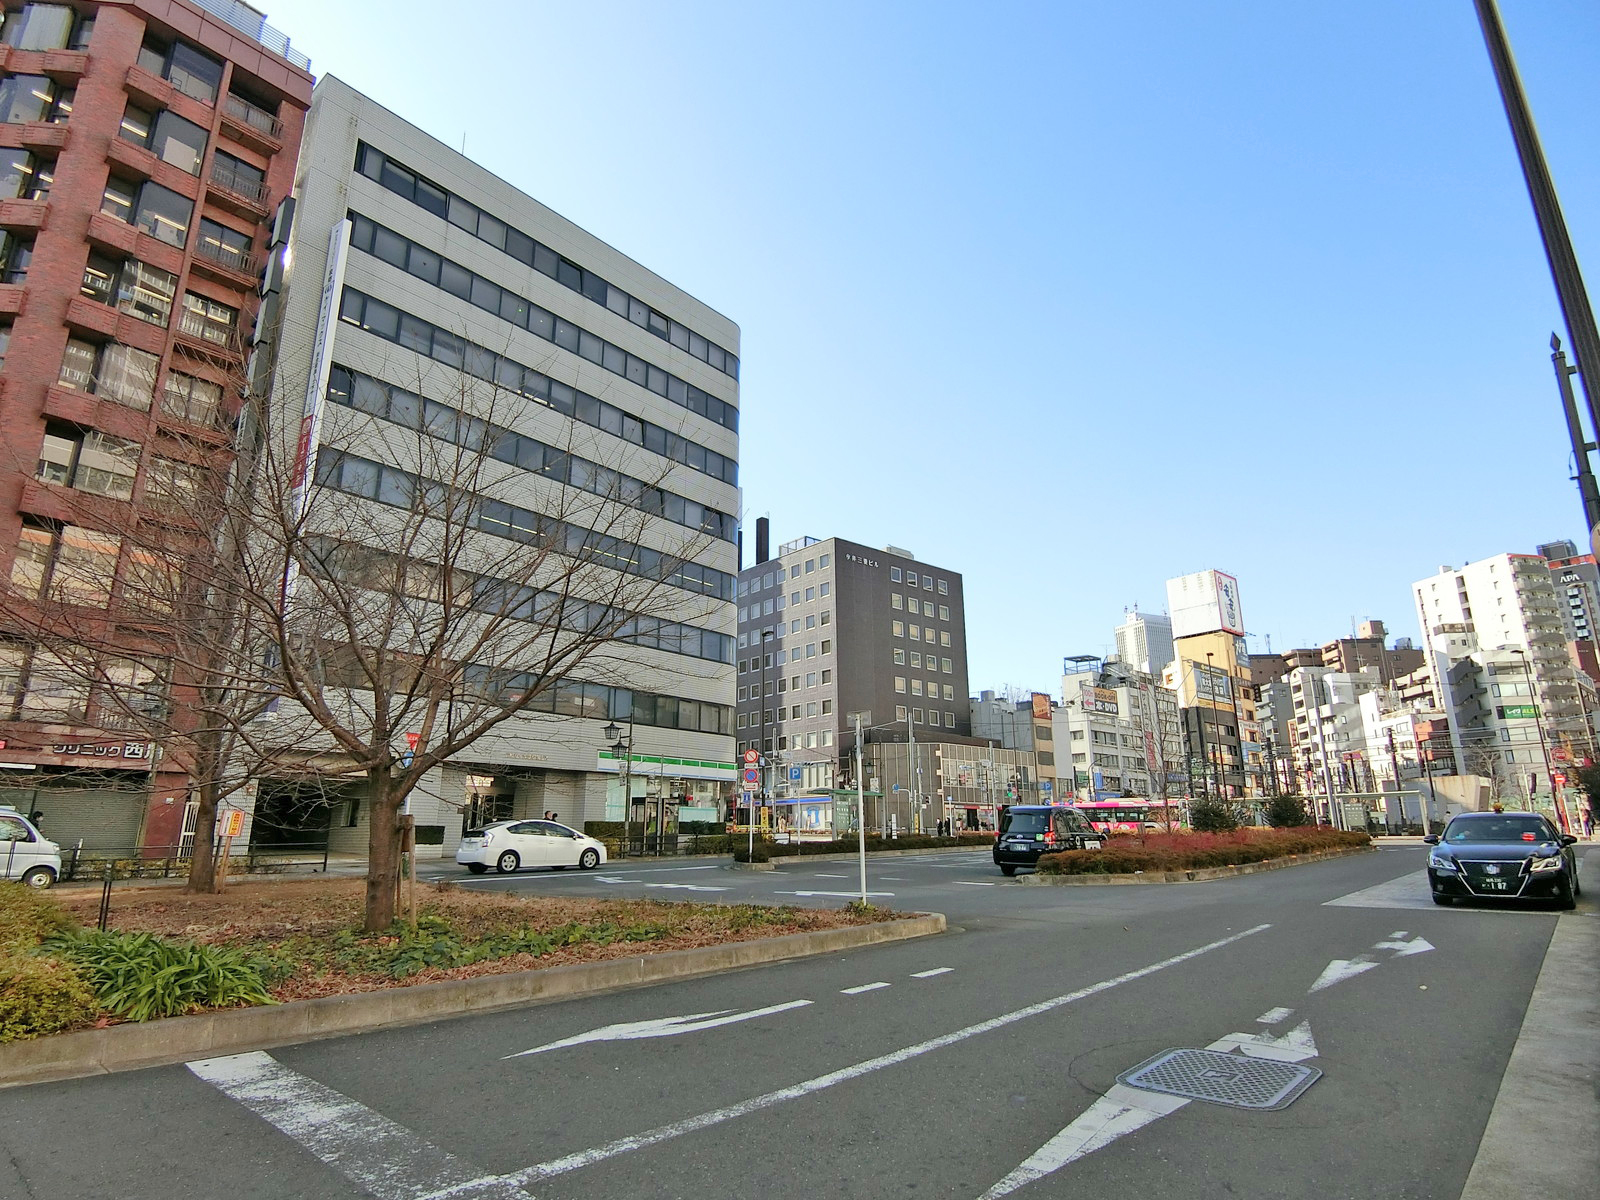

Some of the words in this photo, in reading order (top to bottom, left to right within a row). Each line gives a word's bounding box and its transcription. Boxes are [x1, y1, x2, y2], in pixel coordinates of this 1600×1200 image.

[1559, 573, 1580, 584] APA
[53, 743, 121, 757] クリニック
